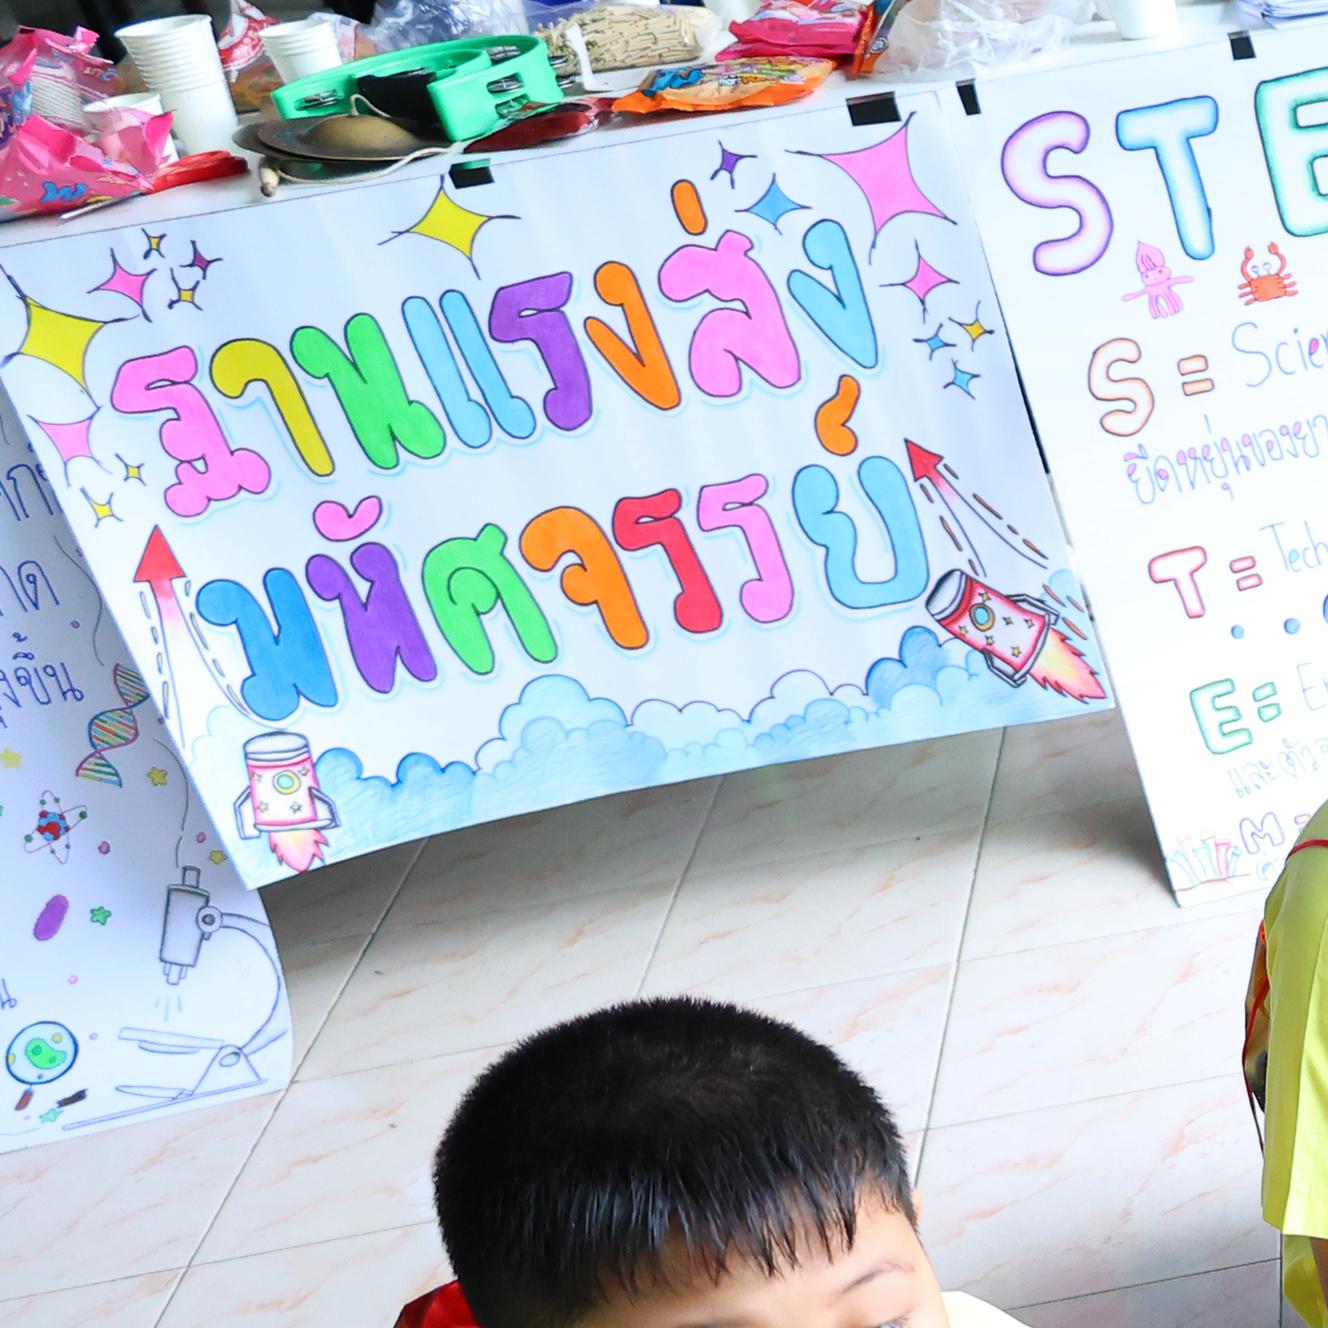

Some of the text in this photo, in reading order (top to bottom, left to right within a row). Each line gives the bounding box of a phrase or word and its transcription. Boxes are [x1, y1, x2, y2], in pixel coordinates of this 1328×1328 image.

[1088, 337, 1155, 437] S
[196, 374, 929, 722] มหัศจรรย์
[1148, 545, 1207, 619] T
[1189, 678, 1253, 755] E
[1239, 812, 1285, 855] M
